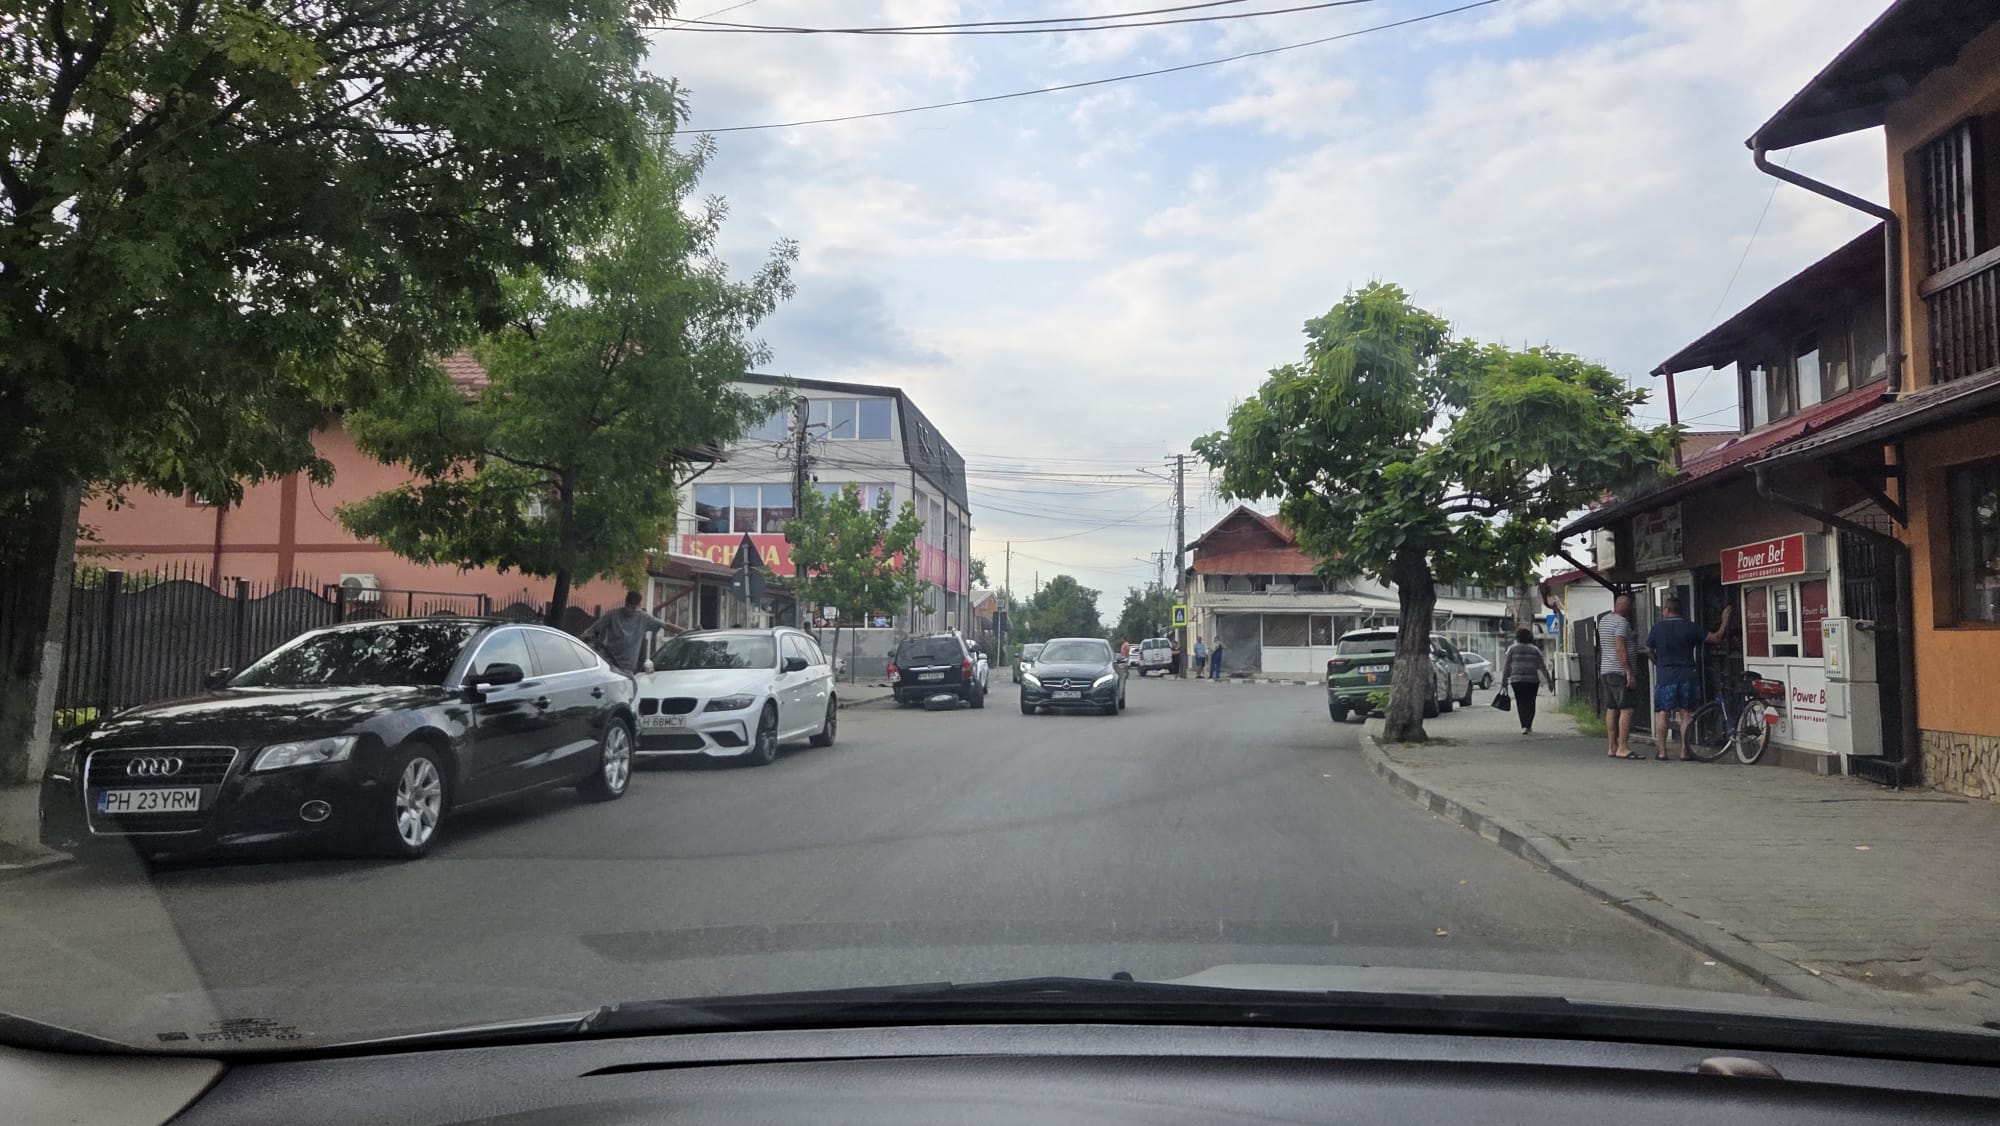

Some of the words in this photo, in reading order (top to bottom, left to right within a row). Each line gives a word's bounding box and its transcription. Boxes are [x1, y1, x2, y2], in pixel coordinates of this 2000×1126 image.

[1737, 551, 1765, 568] Power
[1768, 540, 1784, 563] Bet
[1792, 686, 1818, 703] Power
[106, 792, 131, 810] PH
